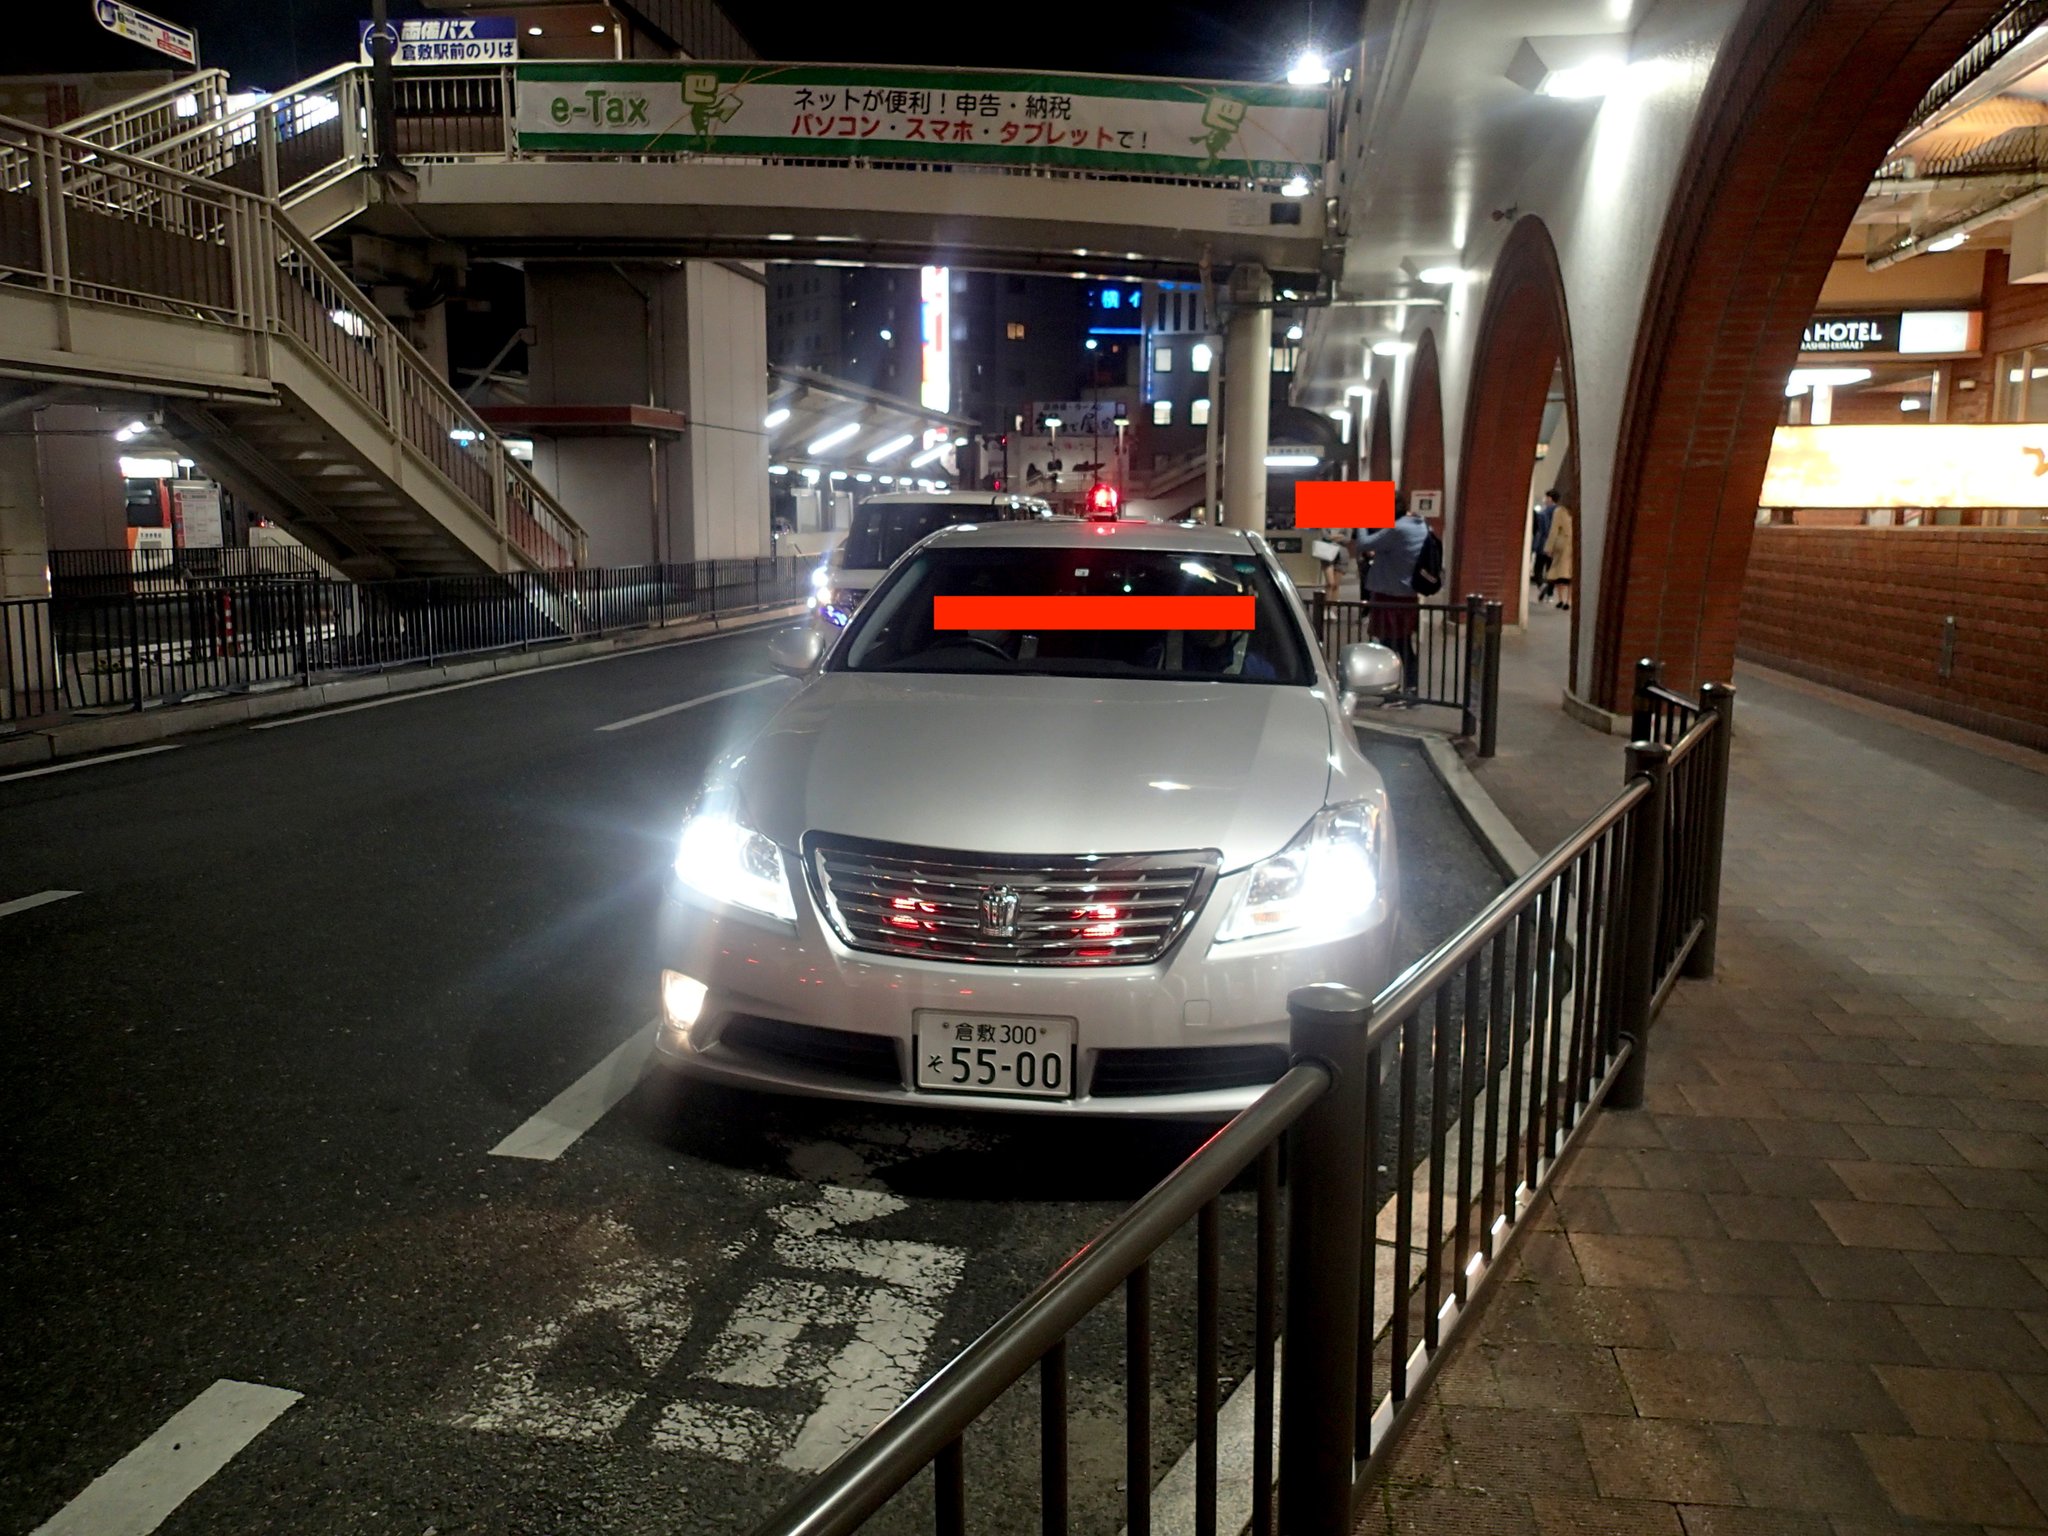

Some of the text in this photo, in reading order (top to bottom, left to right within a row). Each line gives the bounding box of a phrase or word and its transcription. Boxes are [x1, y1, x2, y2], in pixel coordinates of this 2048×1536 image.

[401, 20, 476, 40] 両備バス
[402, 42, 514, 61] 倉敷駅前のりば
[551, 89, 649, 126] e-Tax
[1814, 322, 1882, 342] HOTEL
[952, 1047, 1061, 1089] 55-00
